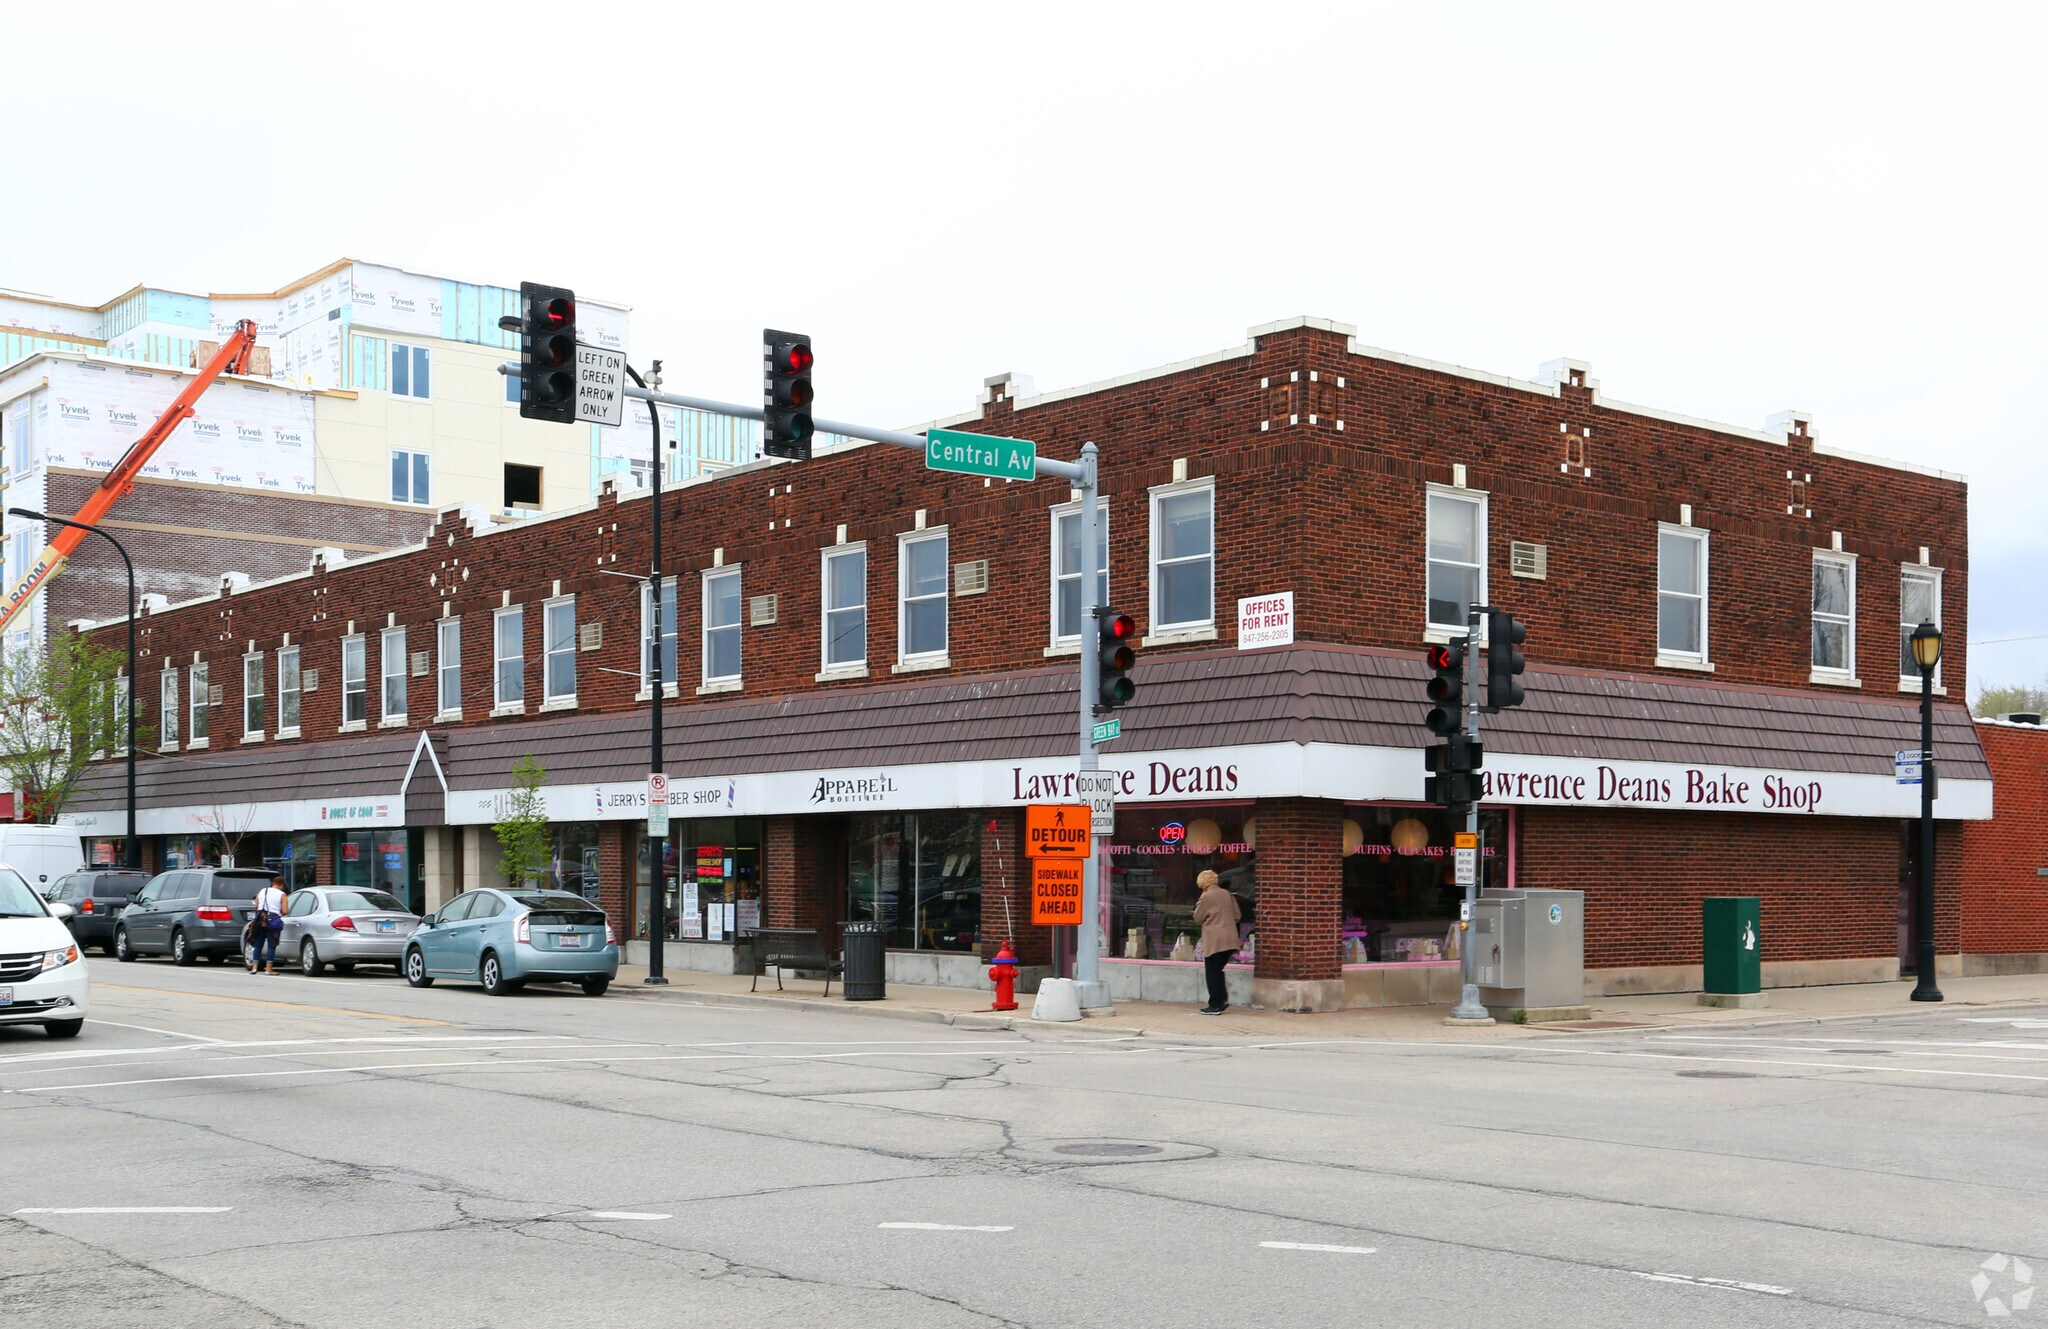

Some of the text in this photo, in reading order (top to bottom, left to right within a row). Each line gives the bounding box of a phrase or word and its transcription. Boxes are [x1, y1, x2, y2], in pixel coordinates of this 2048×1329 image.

[390, 295, 416, 307] Tyvek
[598, 332, 621, 344] Tyvek
[578, 351, 621, 370] LEFT ON
[582, 369, 615, 386] GREEN
[579, 386, 615, 402] ARROW
[60, 403, 90, 416] Tyvek
[107, 409, 138, 422] Tyvek
[582, 403, 609, 418] ONLY
[191, 420, 221, 432] Tyvek
[236, 426, 264, 437] Tyvek
[274, 431, 302, 443] Tyvek
[930, 439, 1032, 471] Central Av
[84, 457, 114, 469] Tyvek
[169, 466, 198, 478] Tyvek
[214, 472, 242, 483] Tyvek
[296, 481, 315, 492] Tyve
[1245, 598, 1285, 616] OFFICES
[1241, 612, 1289, 631] FOR RENT
[1012, 761, 1239, 801] Lawrce Deans
[1081, 777, 1112, 793] DO NOT
[1479, 765, 1823, 814] awrence Deans Bake Shop
[607, 791, 646, 808] JERRY'S
[693, 789, 721, 804] SHOP
[829, 793, 885, 804] BOUTIQUE
[1091, 817, 1113, 827] RSECTION
[1031, 828, 1086, 843] DETOUR
[1159, 826, 1185, 840] OPEN
[1136, 844, 1175, 855] COOKIES
[1181, 843, 1212, 854] FUDGE
[1218, 842, 1253, 854] TOFFEE
[1352, 844, 1392, 855] MUFFINS
[1397, 846, 1444, 857] CUPCAKES
[1037, 869, 1079, 880] SIDEWALK
[1037, 883, 1079, 897] CLOSED
[1039, 900, 1076, 915] AHEAD
